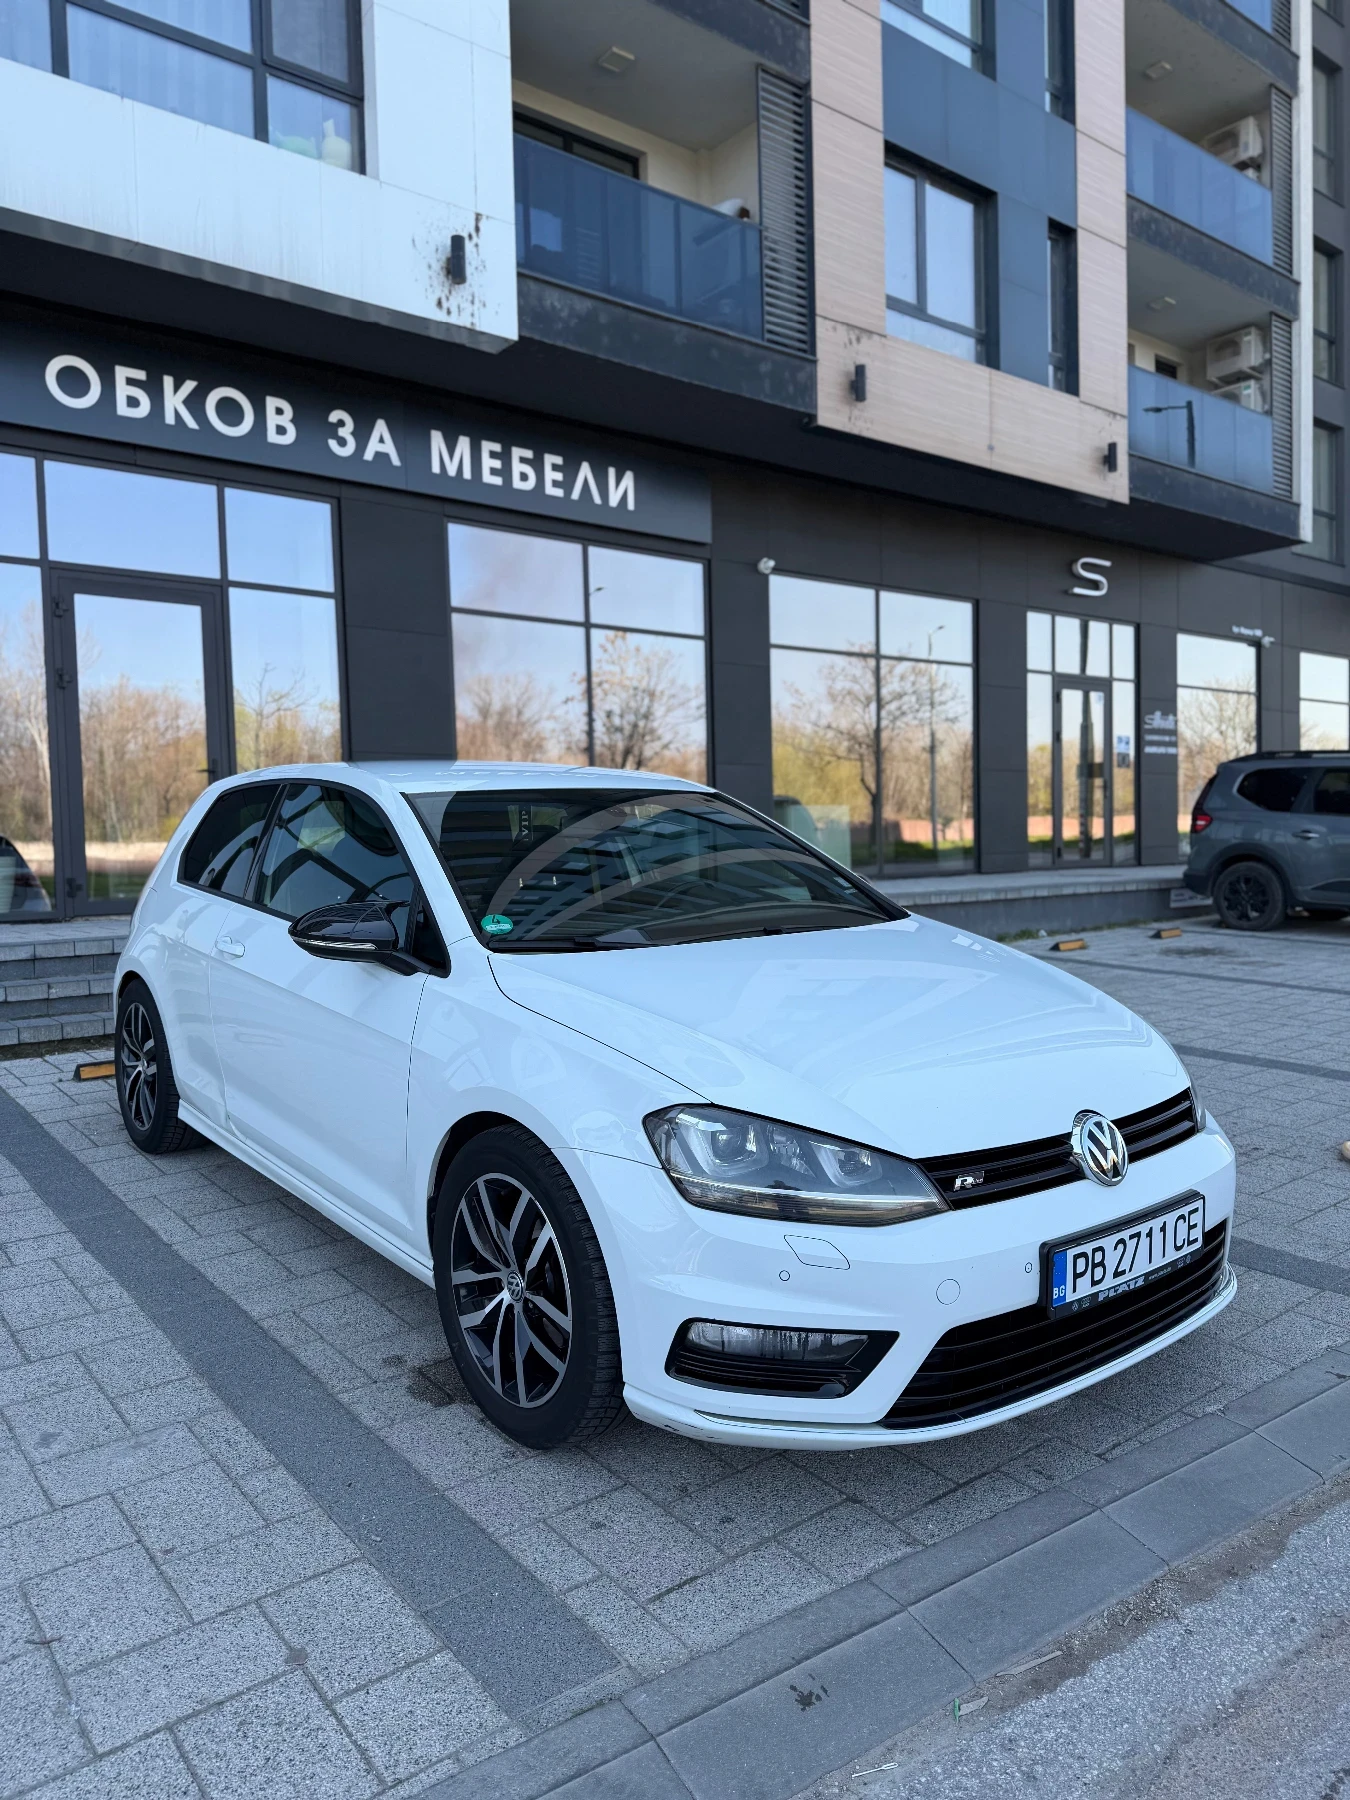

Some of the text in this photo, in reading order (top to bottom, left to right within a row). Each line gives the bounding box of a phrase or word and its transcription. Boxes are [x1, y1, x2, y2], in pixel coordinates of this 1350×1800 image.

[44, 354, 636, 511] ОБКОВ ЗА МЕБЕЛИ
[1072, 557, 1112, 596] S
[1072, 1206, 1200, 1294] PB 2711 CE
[1053, 1285, 1066, 1299] BG
